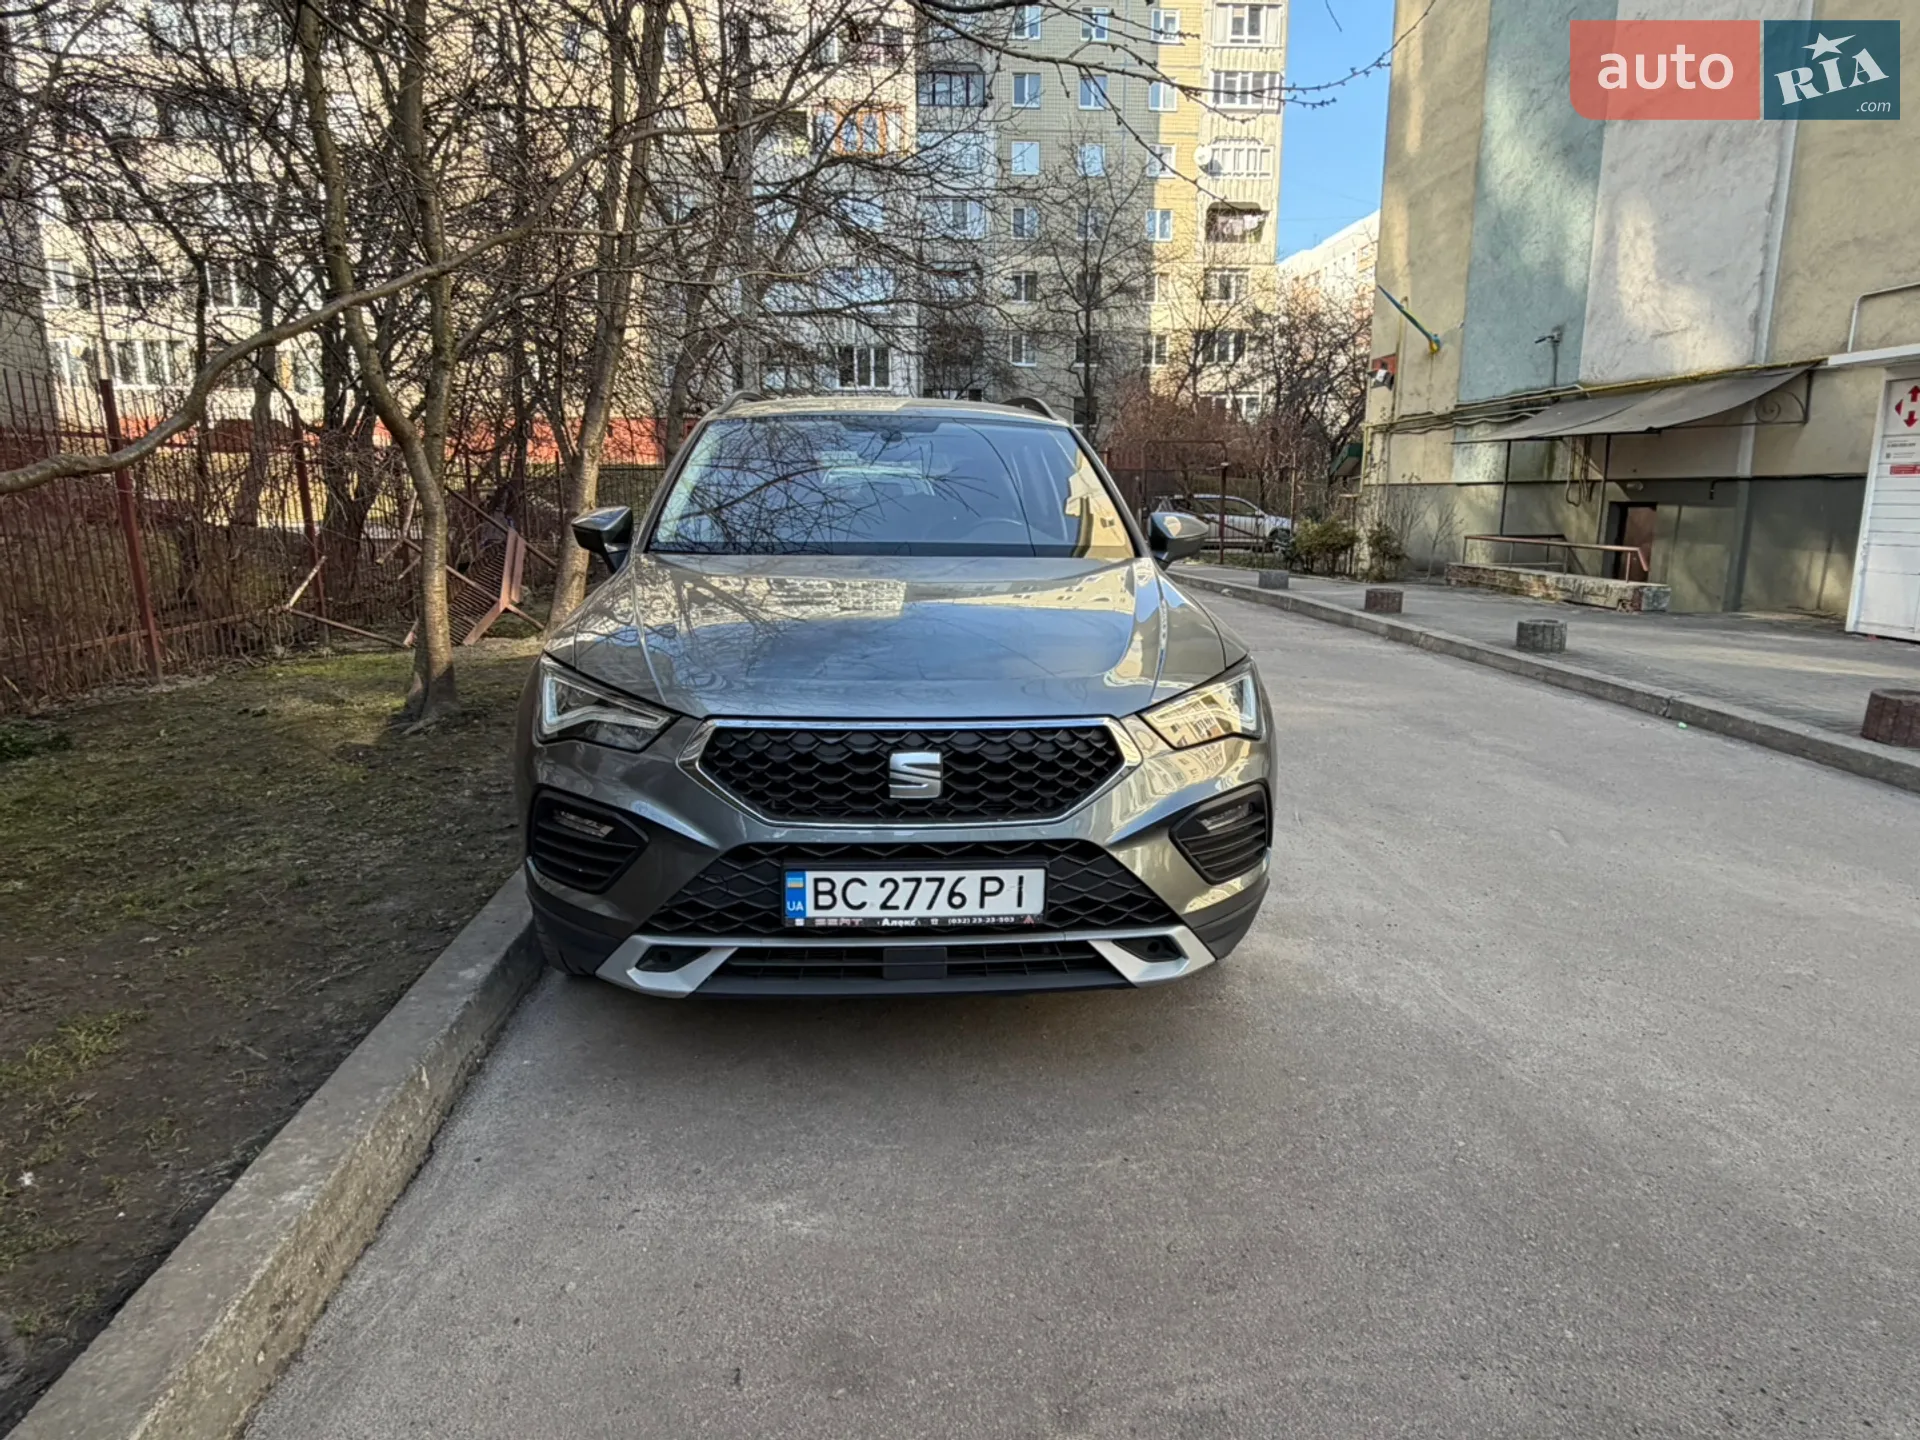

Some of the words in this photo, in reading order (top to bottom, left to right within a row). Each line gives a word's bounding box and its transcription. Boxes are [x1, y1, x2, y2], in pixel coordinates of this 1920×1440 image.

[813, 877, 868, 911] BC
[879, 876, 967, 911] 2776
[979, 875, 1024, 909] PI
[786, 901, 804, 911] UA
